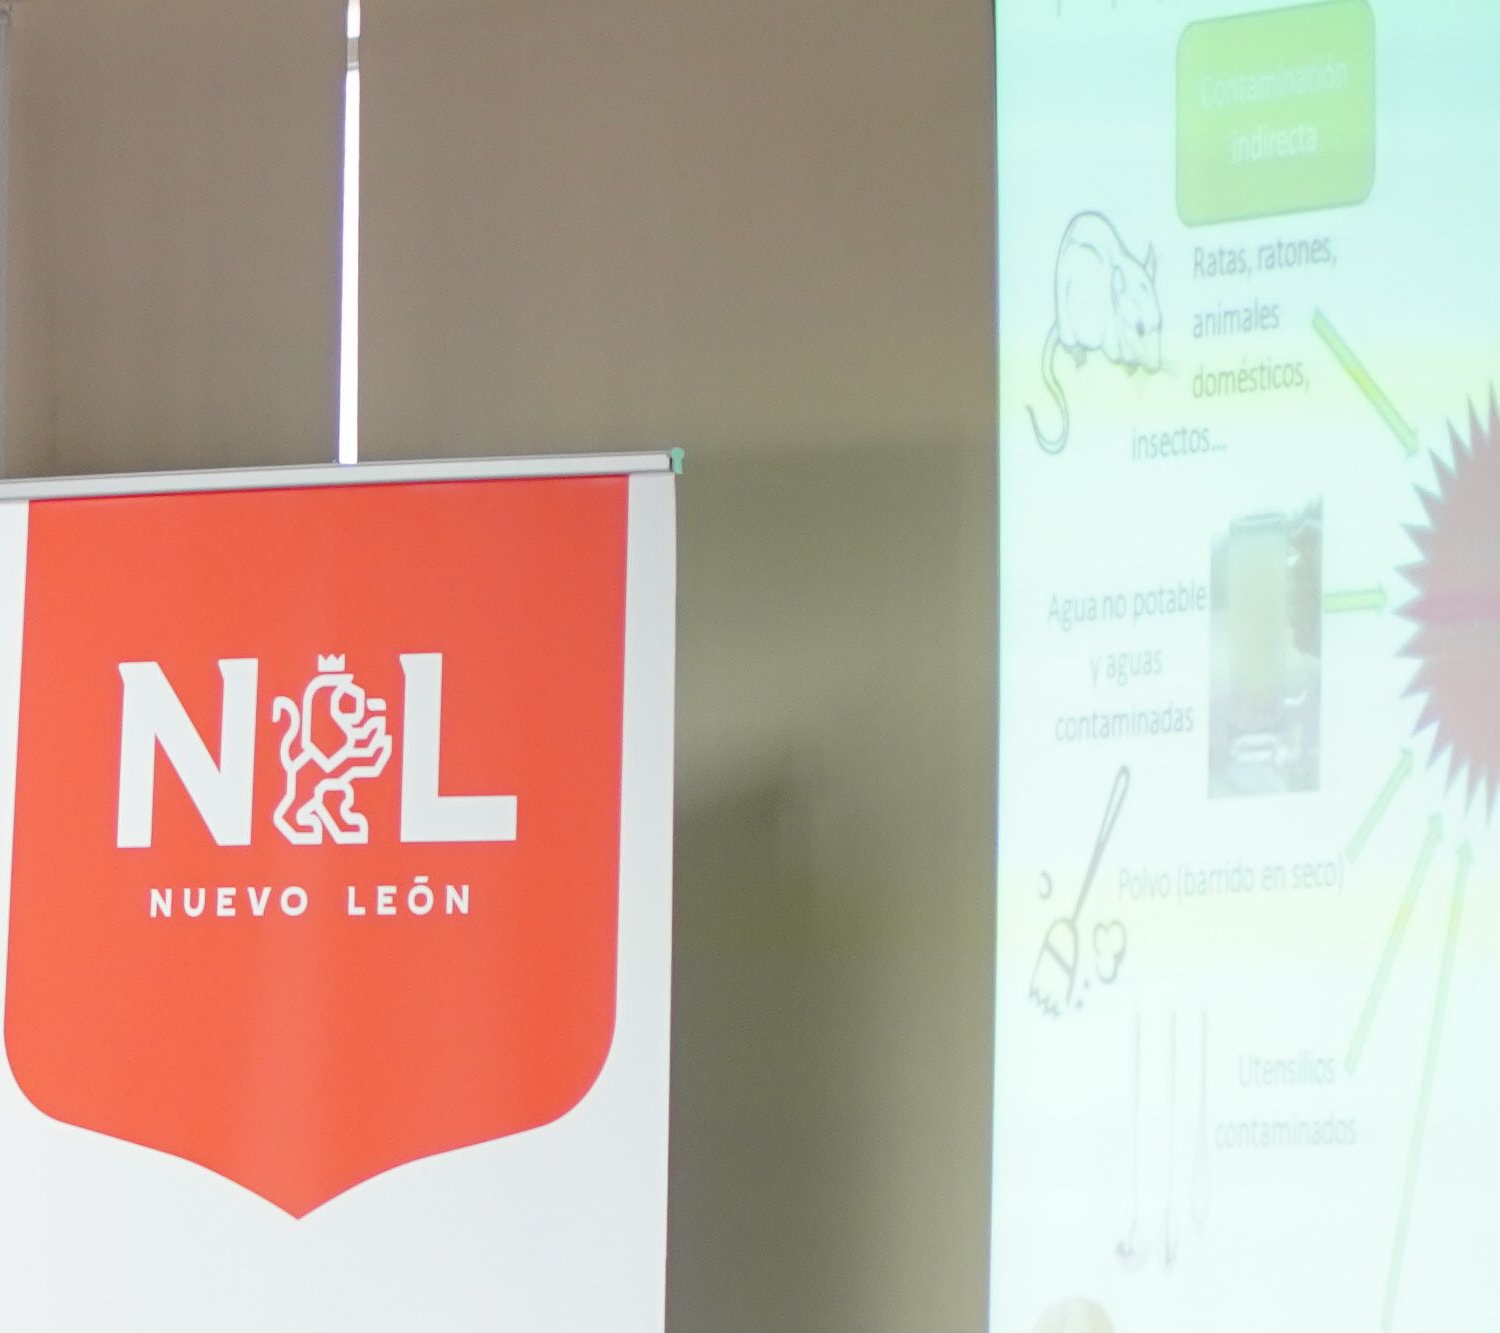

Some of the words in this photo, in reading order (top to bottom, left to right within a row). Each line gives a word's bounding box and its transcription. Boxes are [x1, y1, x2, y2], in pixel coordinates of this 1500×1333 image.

[1230, 123, 1318, 164] indirecta
[1193, 247, 1252, 280] Ratas,
[1257, 235, 1338, 271] ratones,
[1192, 300, 1280, 338] animales
[1192, 357, 1310, 399] domésticos,
[1047, 594, 1098, 633] Agua
[1102, 596, 1128, 621] no
[1132, 583, 1208, 630] potable
[1105, 650, 1163, 687] aguas
[1054, 707, 1194, 742] contaminadas
[150, 887, 309, 917] NUEVO
[348, 876, 470, 915] LEÓN
[1118, 868, 1171, 901] Polvo
[1177, 861, 1254, 905] (barrido
[1261, 868, 1286, 893] en
[1291, 850, 1346, 892] seco)
[1238, 1050, 1336, 1088] Utensilios
[1214, 1112, 1357, 1150] contaminados
